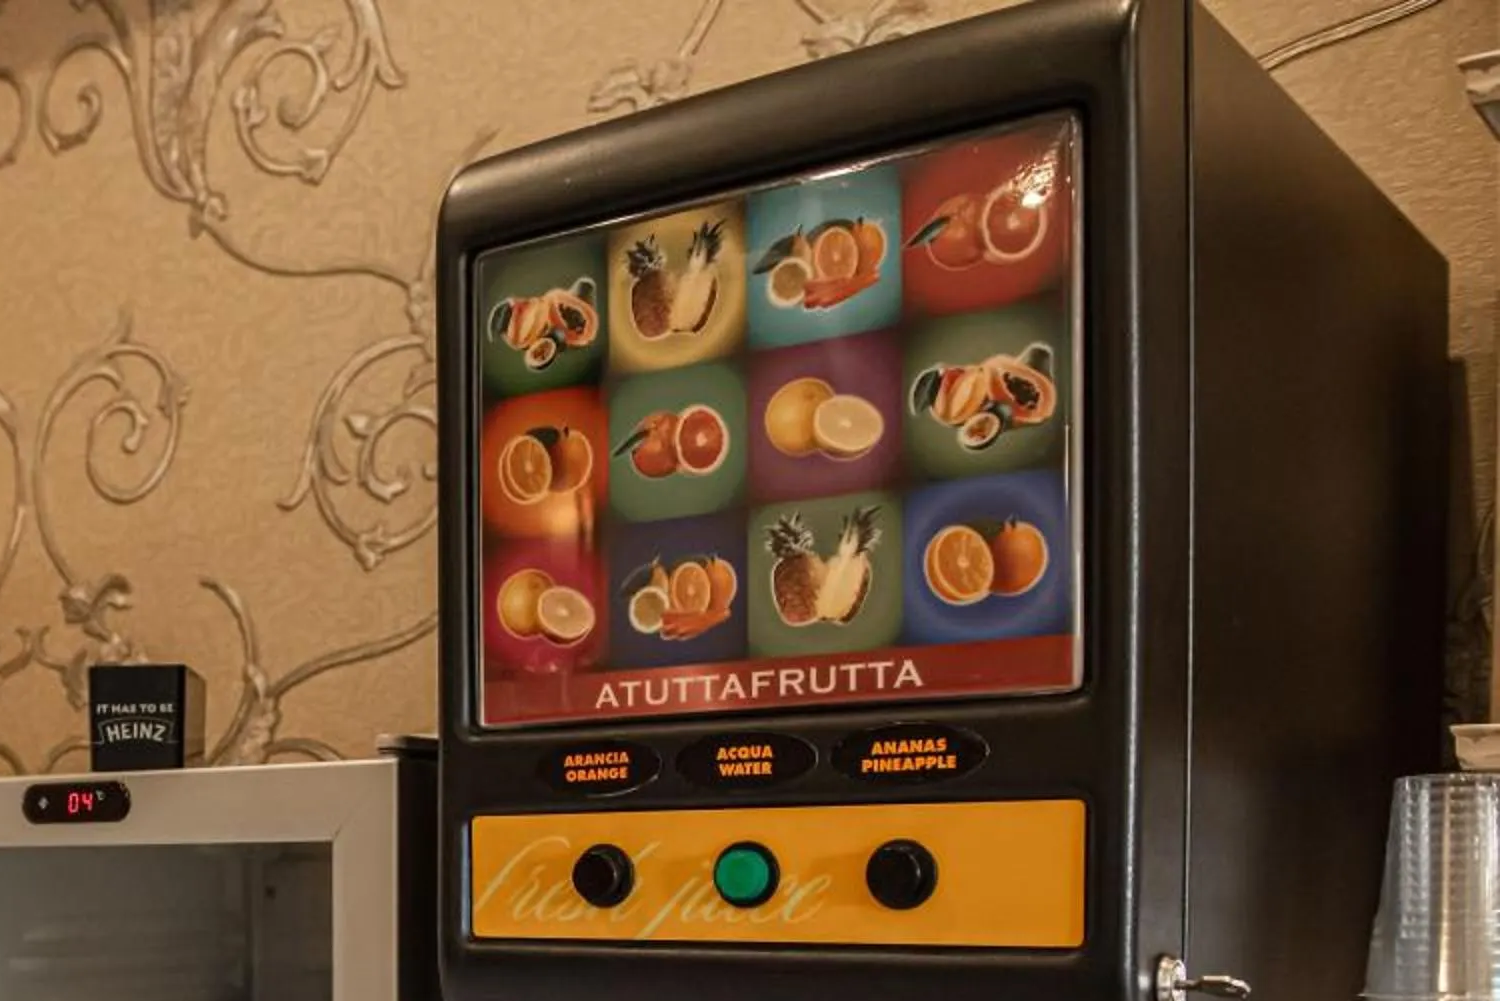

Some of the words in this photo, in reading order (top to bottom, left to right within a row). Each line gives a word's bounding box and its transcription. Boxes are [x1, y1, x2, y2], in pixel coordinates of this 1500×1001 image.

[595, 659, 924, 709] ATUTTAFRUTTA
[96, 703, 109, 715] IT
[111, 703, 137, 714] HAS
[139, 703, 157, 714] TO
[160, 703, 174, 714] BE
[106, 721, 167, 743] HEINZ
[716, 745, 774, 761] ACQUA
[871, 737, 947, 756] ANANAS
[564, 751, 630, 768] ARANCIA
[861, 754, 957, 773] PINEAPPLE
[565, 766, 629, 783] ORANGE
[719, 761, 773, 777] WATER
[67, 792, 94, 814] 04
